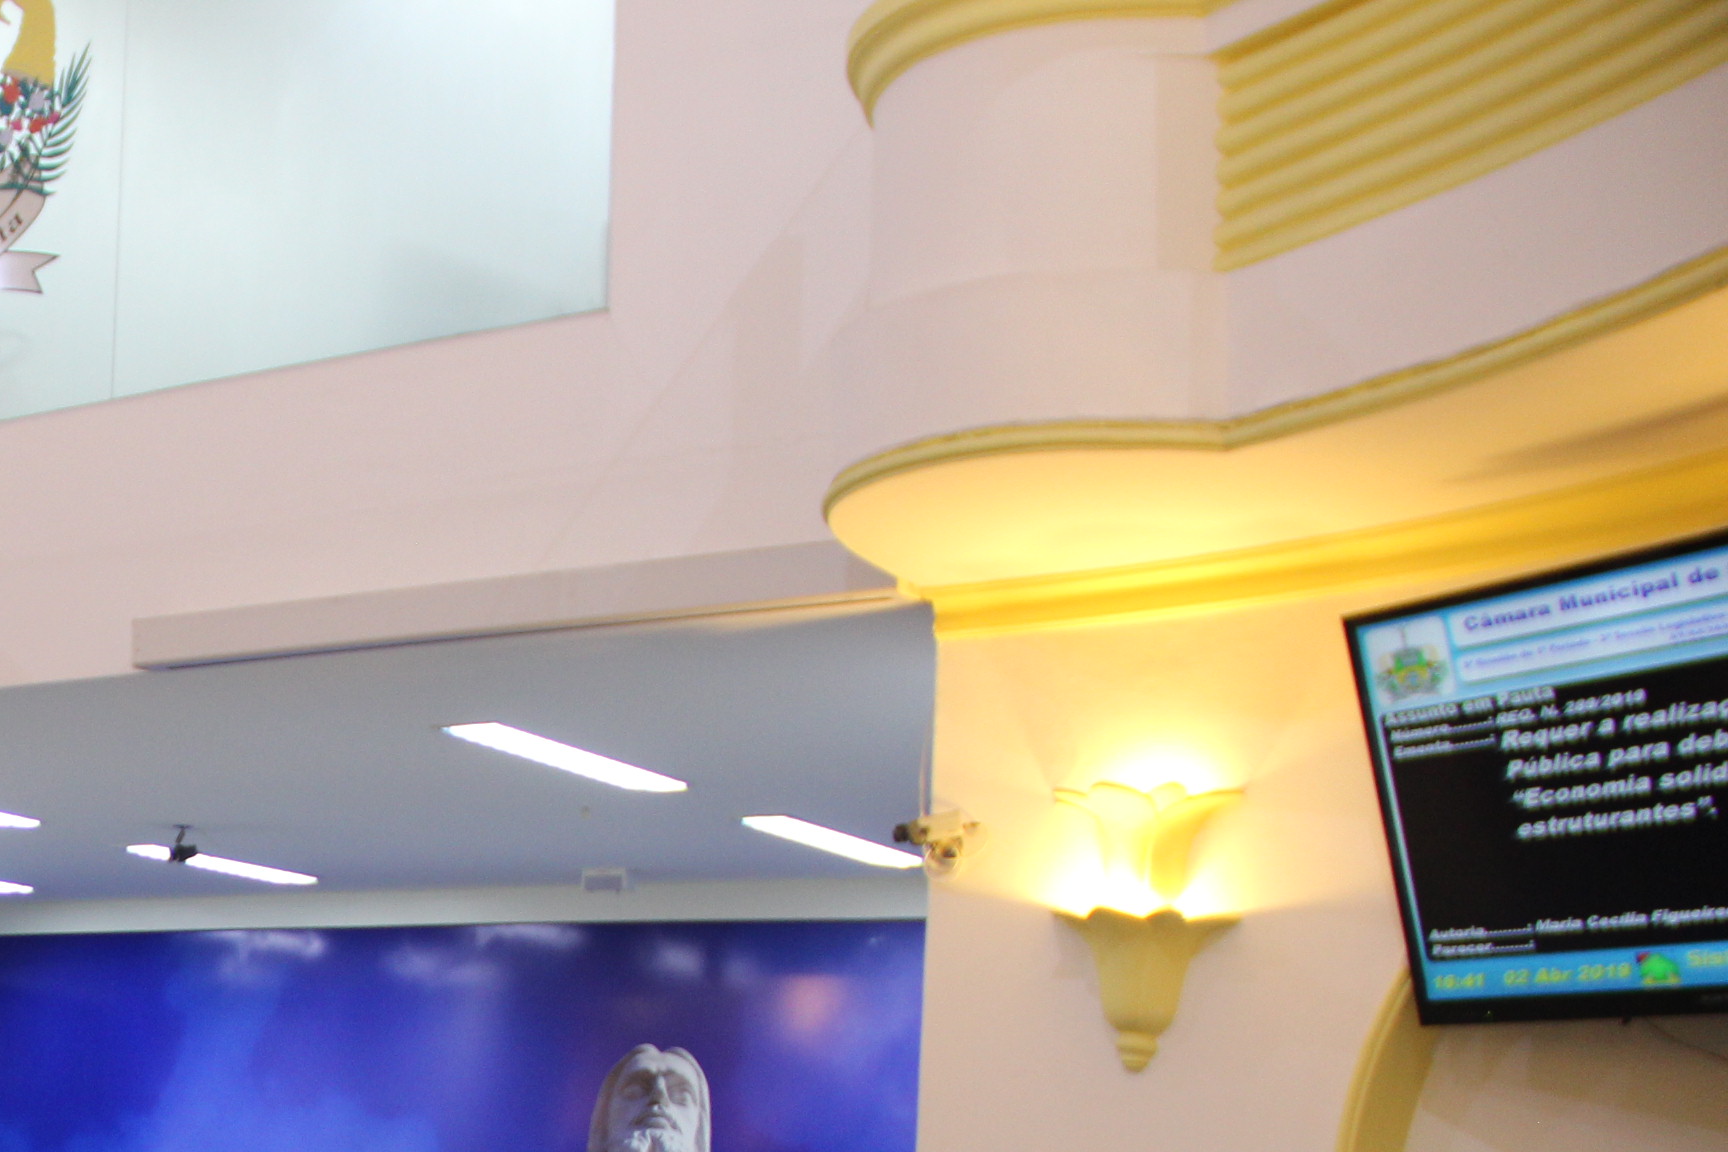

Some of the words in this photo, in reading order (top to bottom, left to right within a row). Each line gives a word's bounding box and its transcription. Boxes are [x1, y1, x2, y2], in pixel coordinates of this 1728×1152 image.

[1462, 603, 1551, 632] Câmara
[1558, 570, 1679, 612] Municipal
[1687, 565, 1720, 585] de
[1501, 720, 1594, 752] Requer
[1597, 718, 1617, 737] a
[1506, 751, 1602, 780] Pública
[1607, 741, 1671, 769] para
[1535, 916, 1584, 934] Maria
[1534, 966, 1572, 984] Abr
